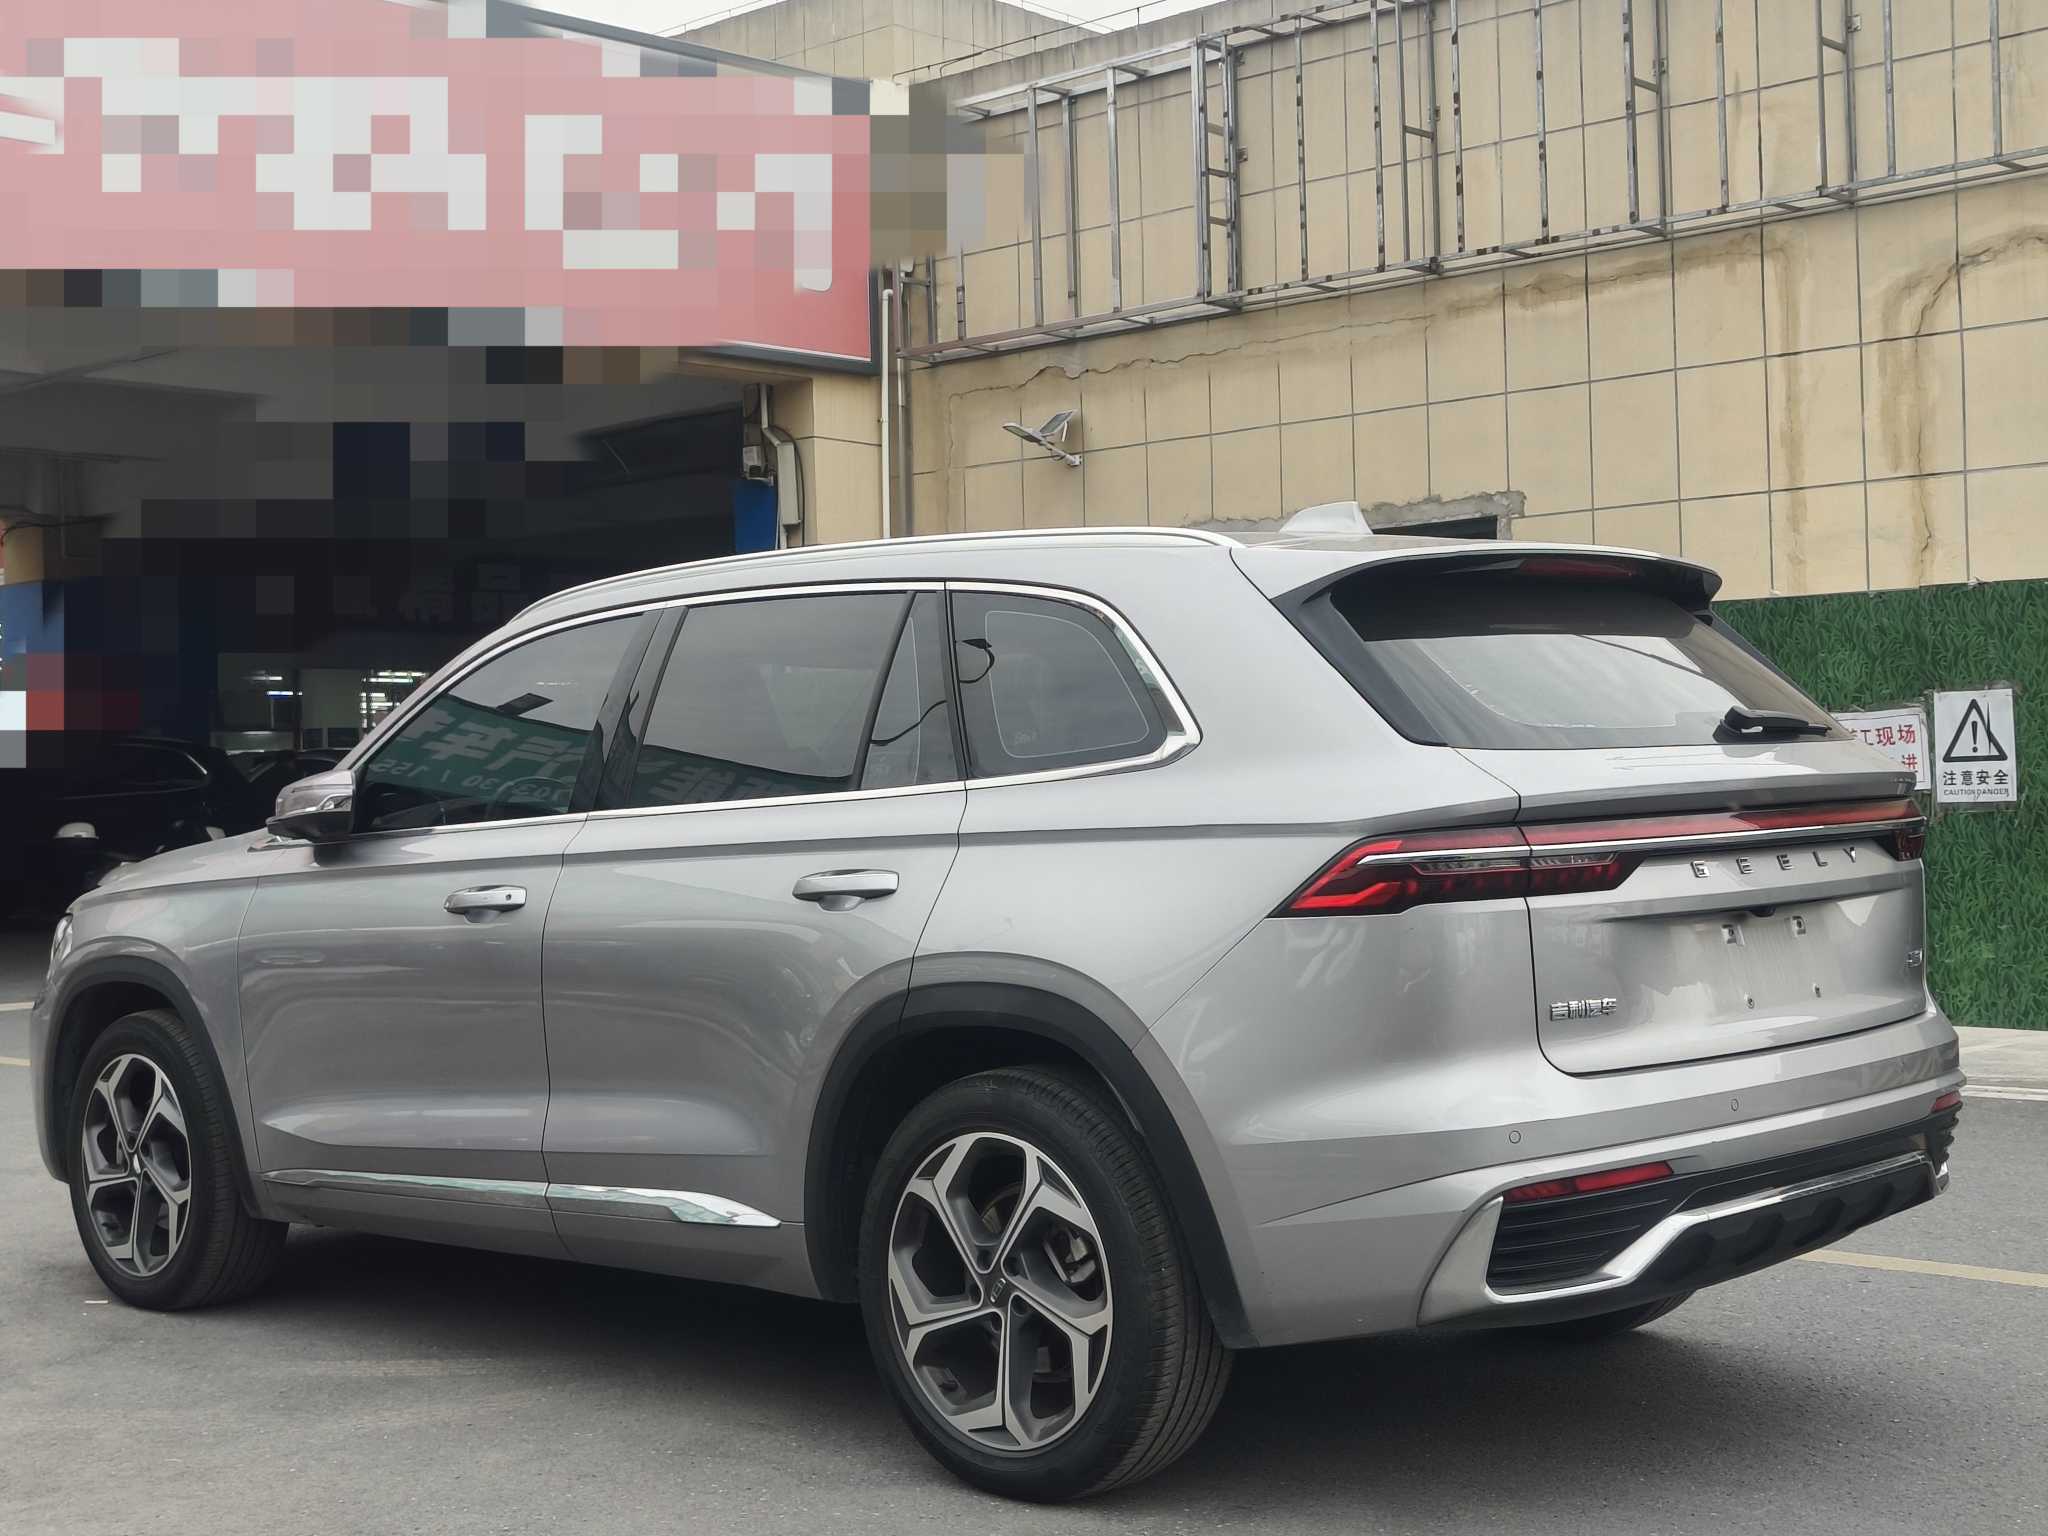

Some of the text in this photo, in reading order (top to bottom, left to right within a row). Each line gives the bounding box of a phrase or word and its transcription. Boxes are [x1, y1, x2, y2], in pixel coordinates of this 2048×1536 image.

[1851, 724, 1916, 746] 工现场
[1943, 769, 2009, 786] 注意安全
[1691, 846, 1856, 878] GEELY
